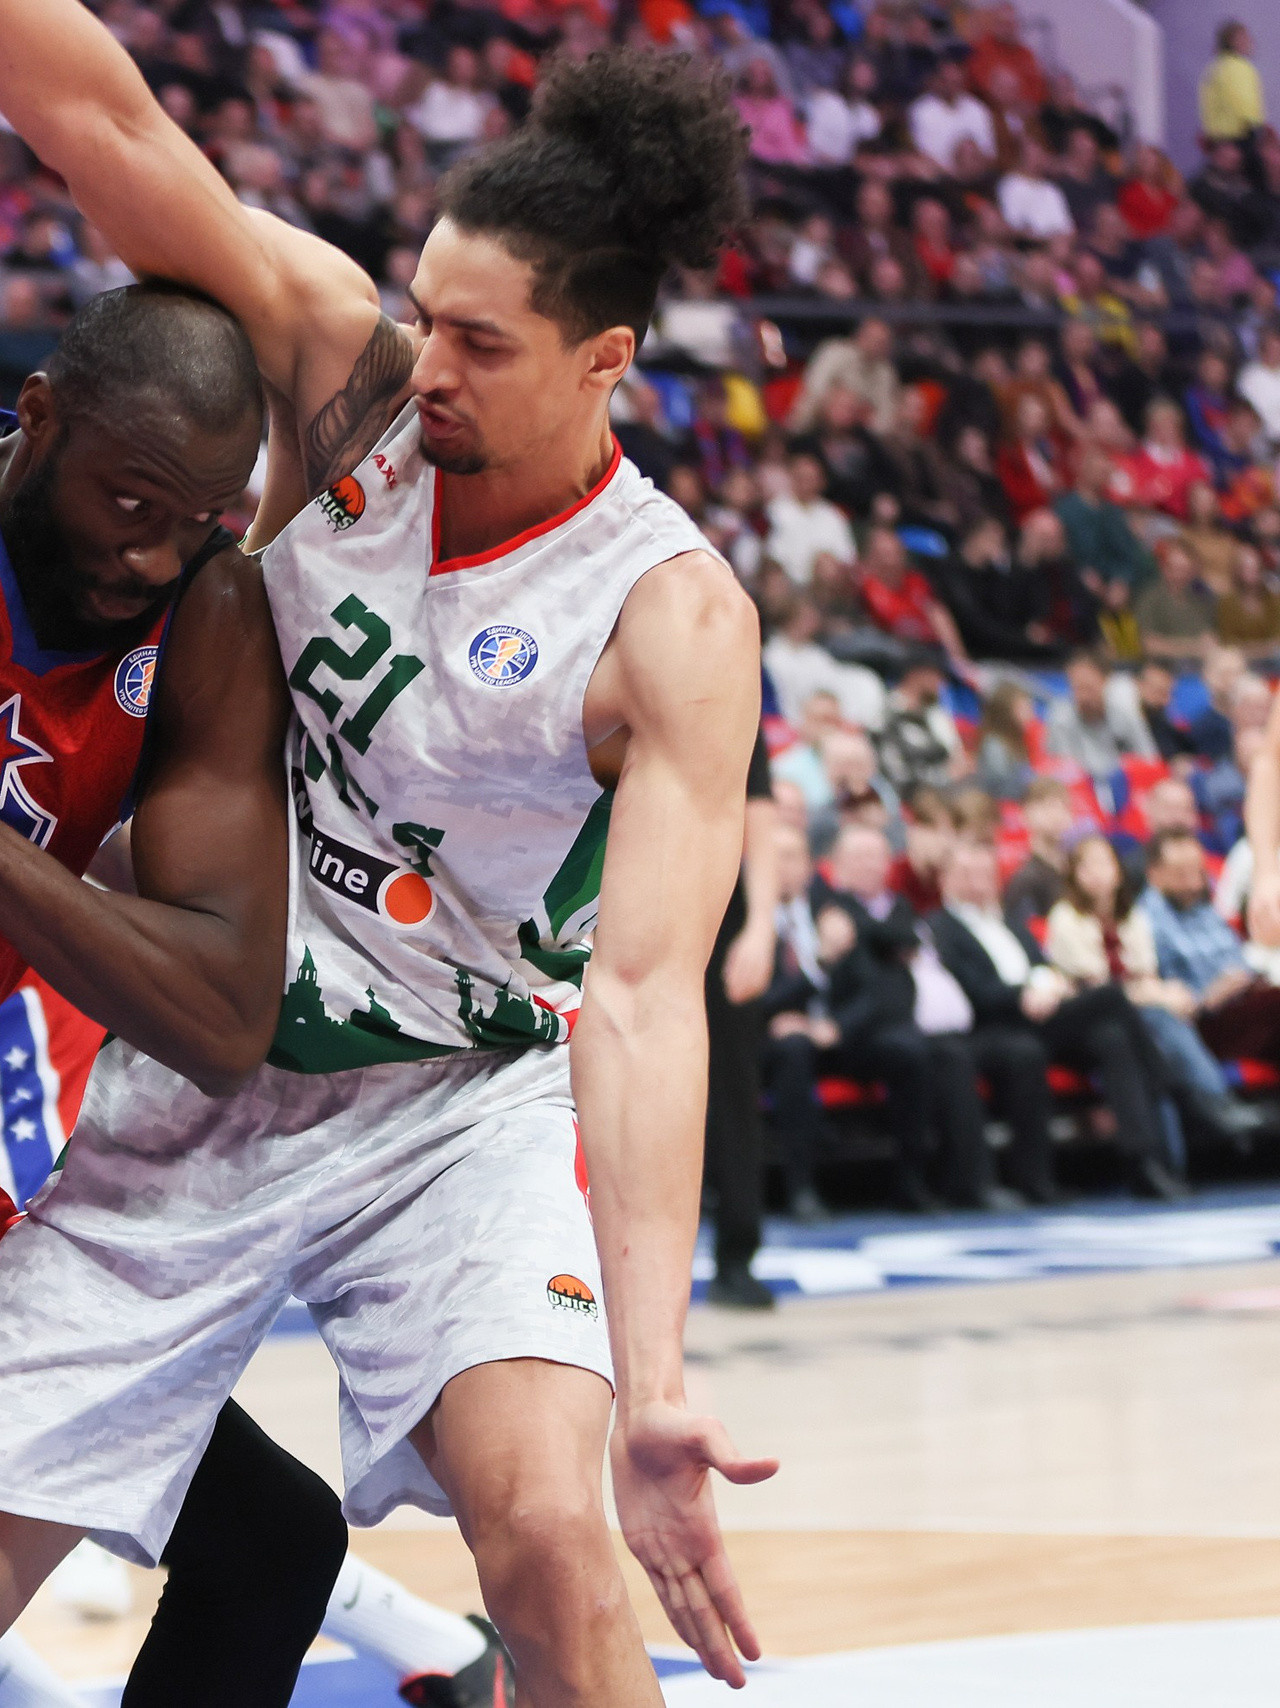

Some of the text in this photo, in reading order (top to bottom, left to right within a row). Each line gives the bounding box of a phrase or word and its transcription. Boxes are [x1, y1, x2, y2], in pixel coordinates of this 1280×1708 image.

[288, 593, 426, 757] 21
[123, 699, 143, 714] UNITED
[547, 1289, 598, 1319] UNICS
